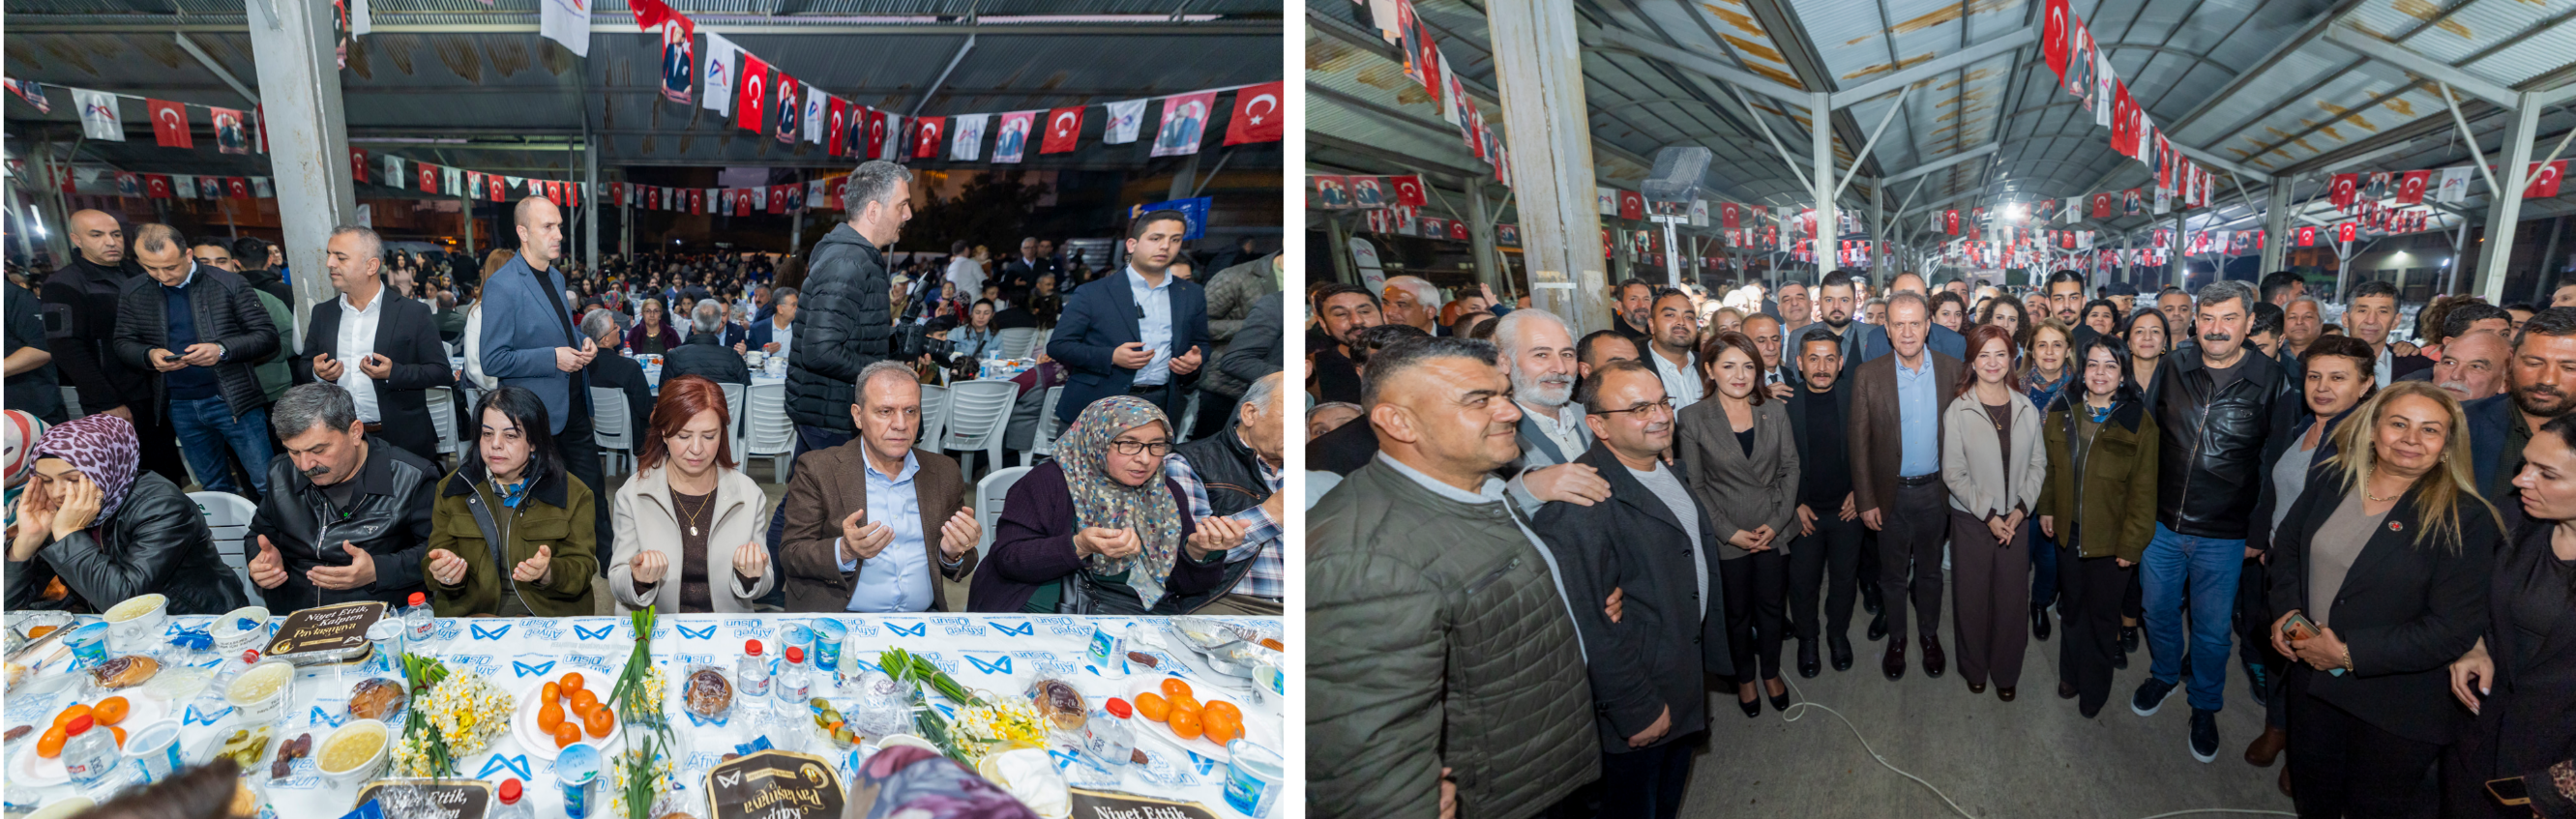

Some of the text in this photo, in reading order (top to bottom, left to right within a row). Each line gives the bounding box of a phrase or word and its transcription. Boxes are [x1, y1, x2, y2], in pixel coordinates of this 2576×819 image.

[305, 605, 369, 622] Niyet Ettik,
[318, 614, 364, 627] Kalpten
[724, 619, 762, 628] Olsun
[734, 628, 774, 638] Afiyet
[848, 627, 879, 637] Afiye
[744, 783, 822, 814] Paylaşmaya
